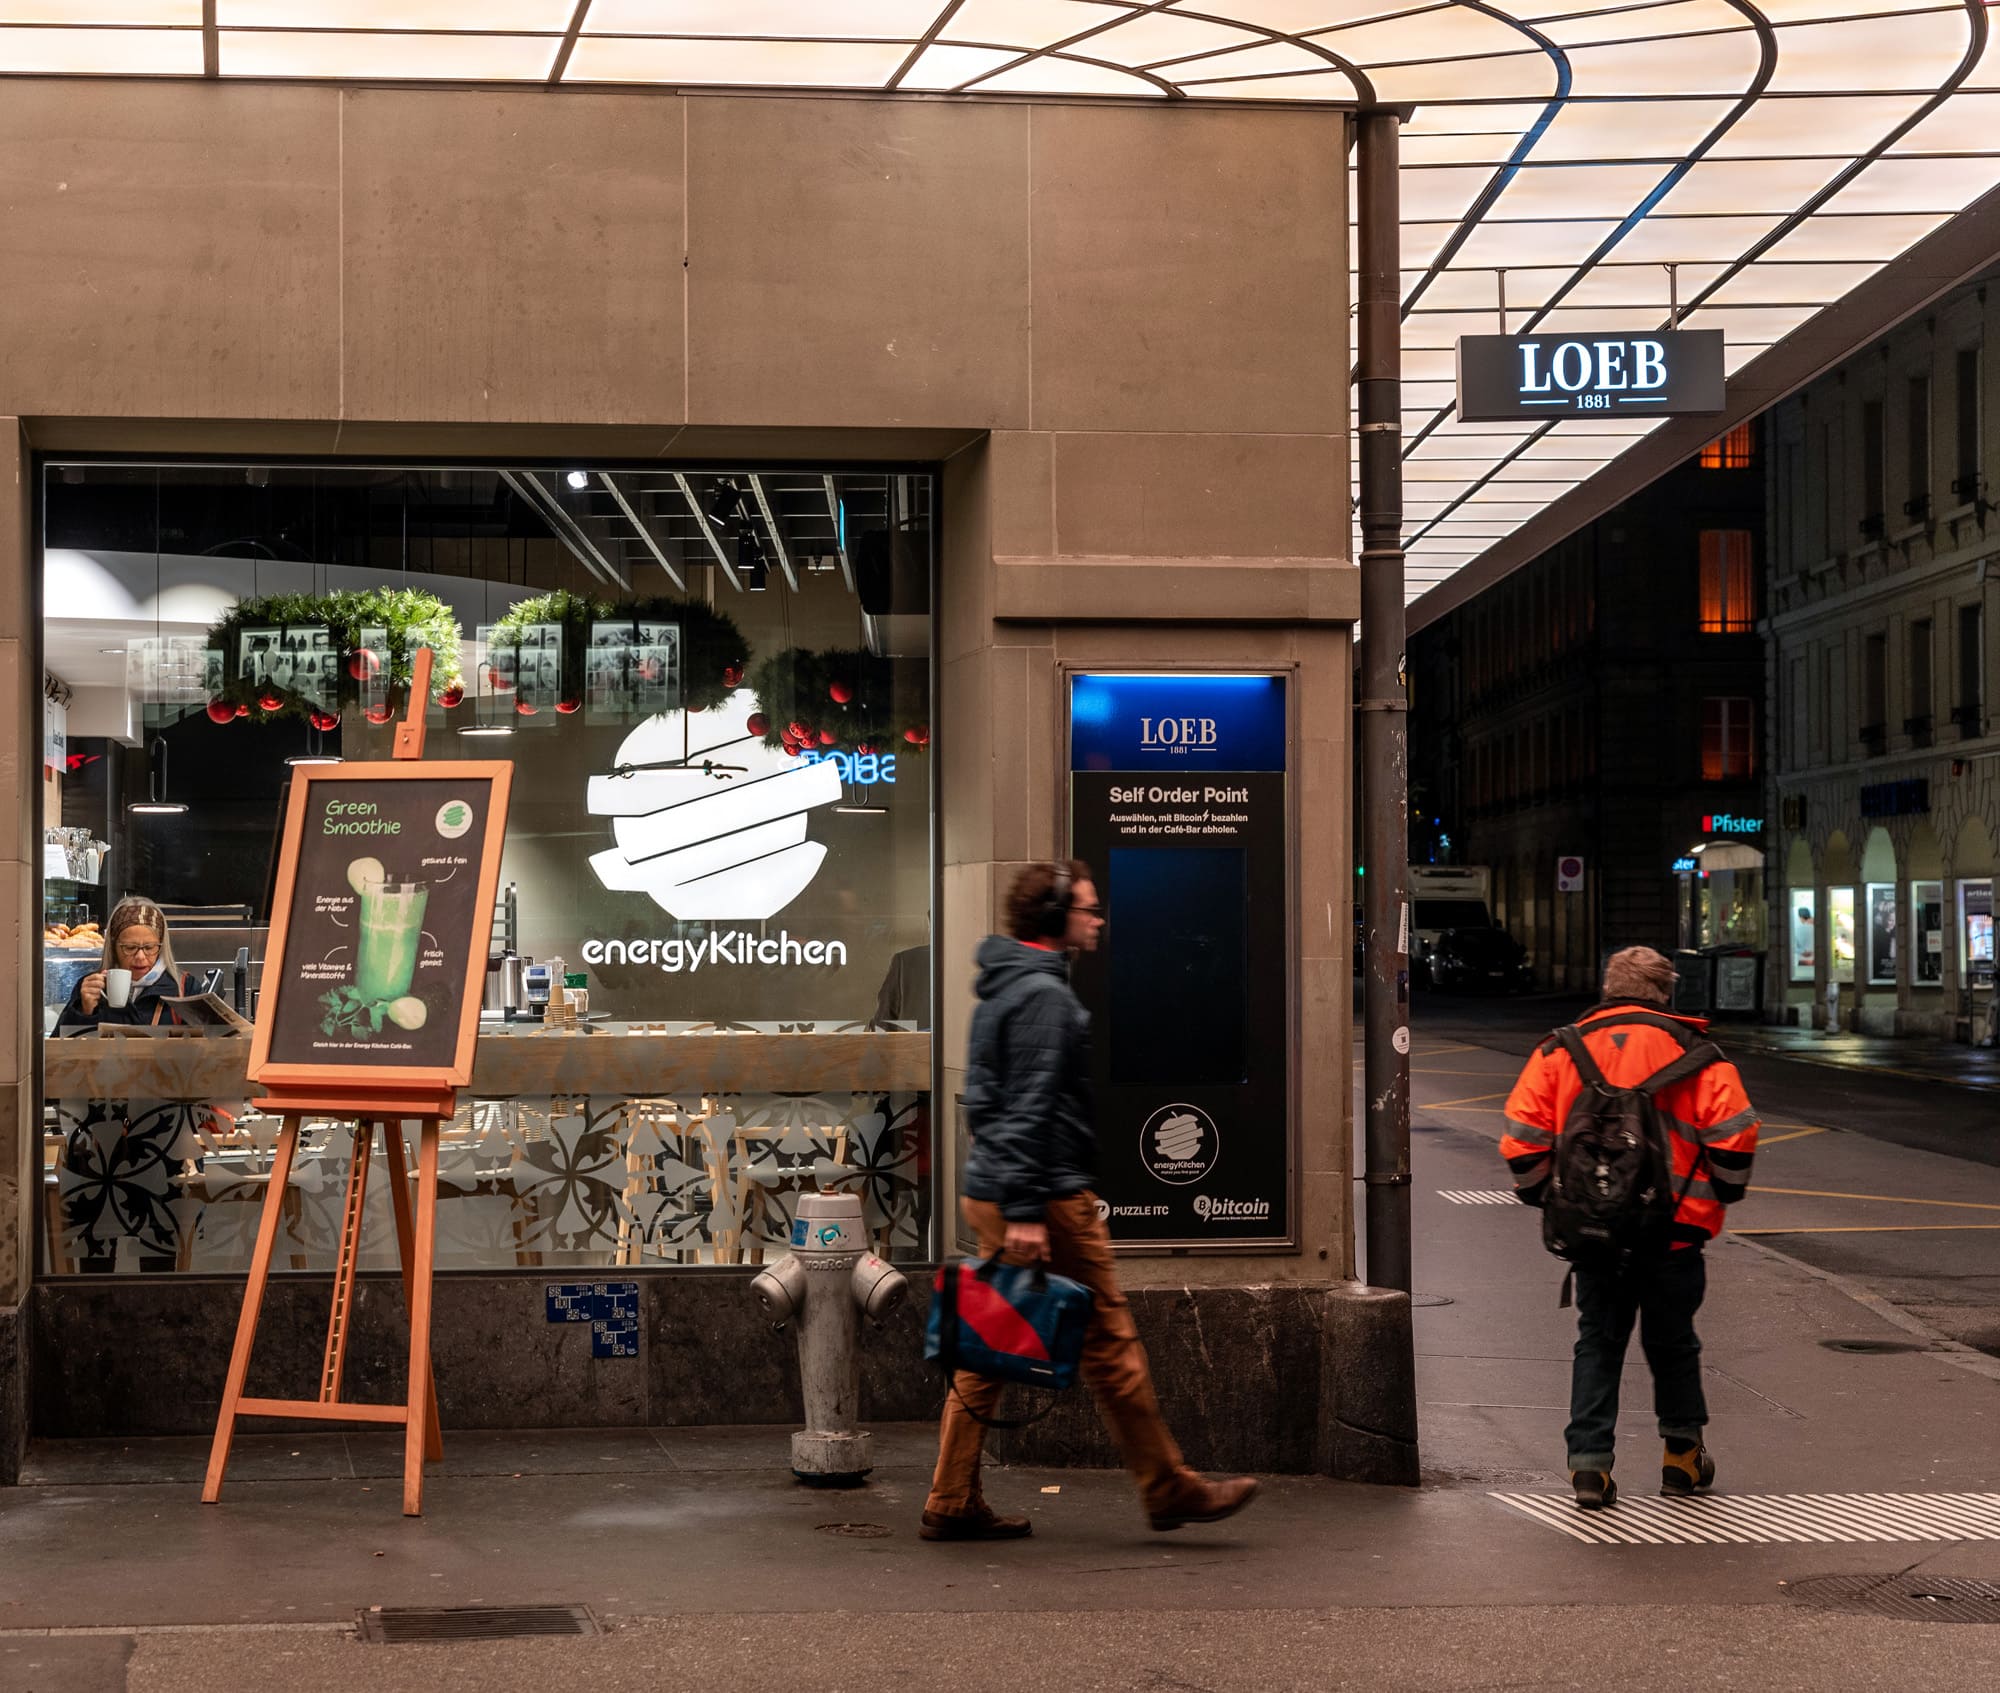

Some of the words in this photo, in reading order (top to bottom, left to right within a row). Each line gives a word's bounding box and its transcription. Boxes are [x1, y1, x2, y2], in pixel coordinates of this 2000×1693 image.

[1519, 340, 1667, 392] LOEB
[1576, 395, 1611, 409] 1881
[1140, 718, 1217, 744] LOEB
[1170, 746, 1188, 754] 1881
[1109, 787, 1145, 803] Self
[1149, 787, 1200, 803] Order
[1204, 787, 1249, 803] Point
[326, 800, 377, 815] Green
[1109, 813, 1157, 823] Auswählen,
[1158, 813, 1172, 822] mit
[1174, 813, 1202, 822] Bitcoin
[1211, 813, 1248, 822] bezahlen
[1712, 814, 1764, 832] Pfister
[323, 818, 401, 835] Smoothie
[1121, 825, 1137, 834] und
[1138, 825, 1147, 833] in
[1148, 825, 1162, 833] der
[1164, 825, 1201, 833] Café-Bar
[1202, 825, 1238, 833] abholen.
[581, 930, 847, 972] energyKitchen
[1154, 1161, 1206, 1170] energyKitchen
[1113, 1206, 1151, 1216] PUZZLE
[1153, 1205, 1169, 1215] ITC
[1211, 1198, 1270, 1215] bitcoin
